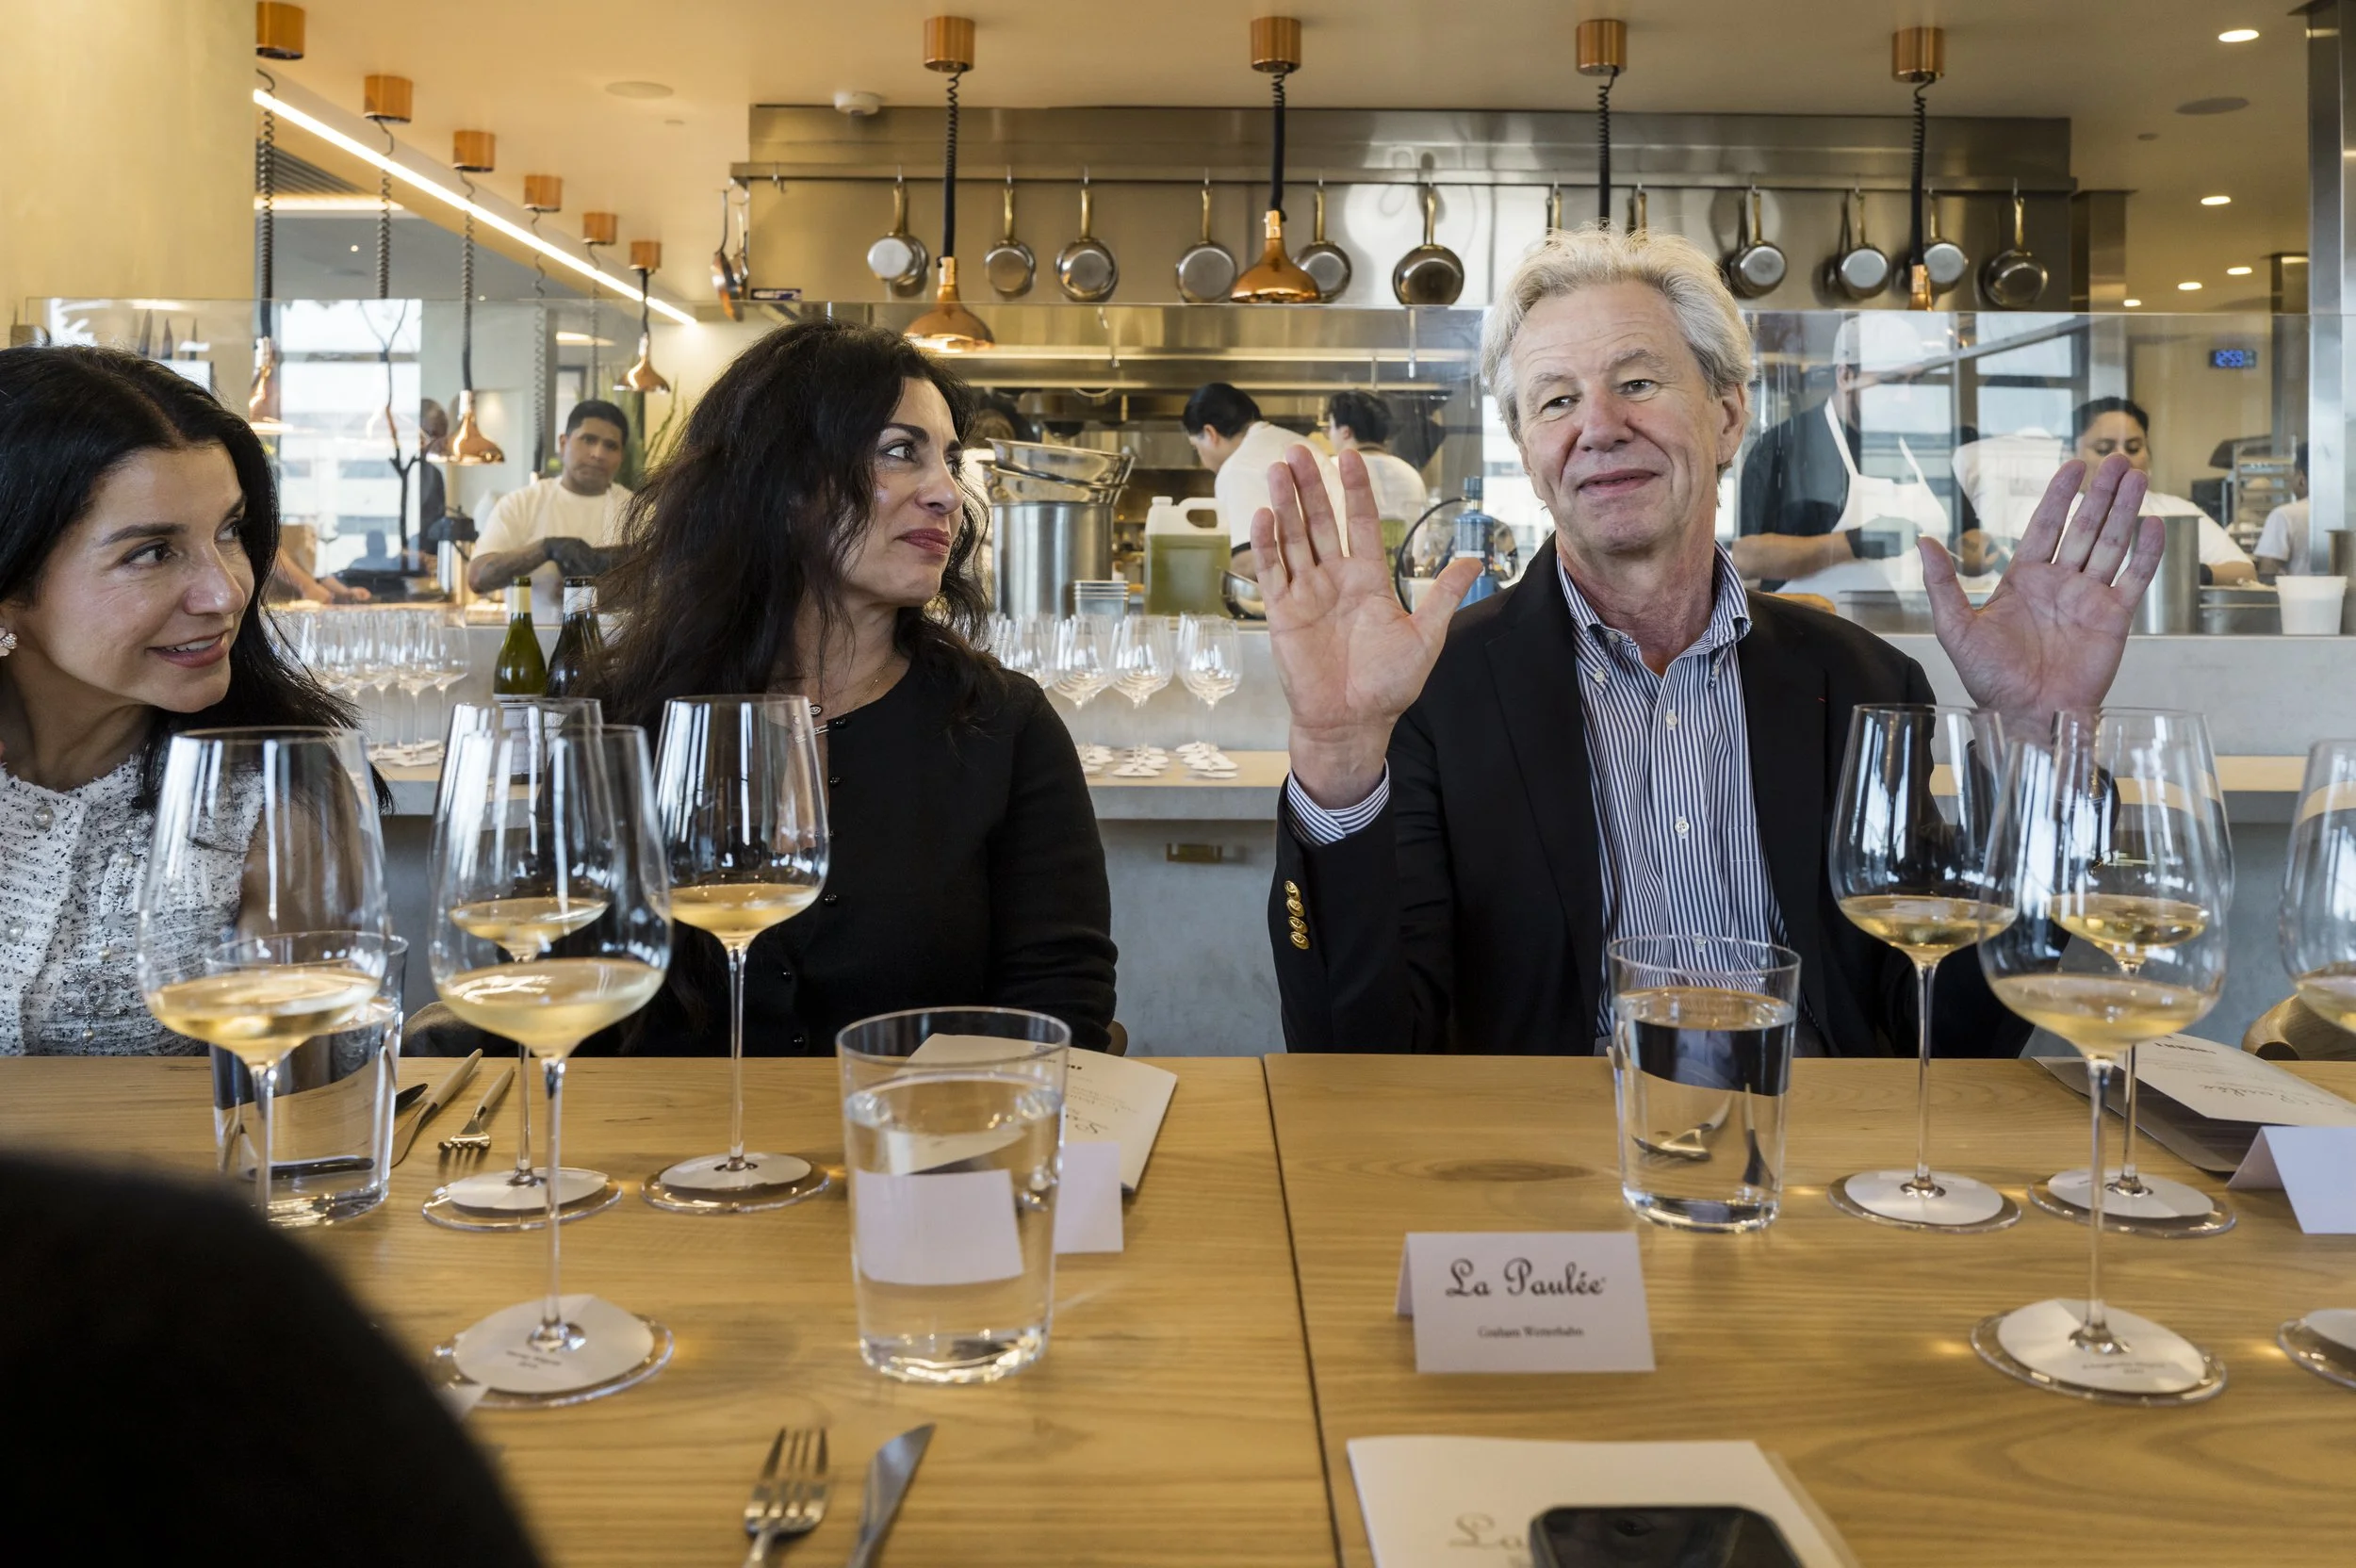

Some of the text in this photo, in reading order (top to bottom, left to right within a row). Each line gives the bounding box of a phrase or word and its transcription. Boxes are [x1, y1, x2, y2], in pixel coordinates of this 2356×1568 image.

[1446, 1257, 1604, 1298] La Paulée
[1448, 1511, 1528, 1551] La
